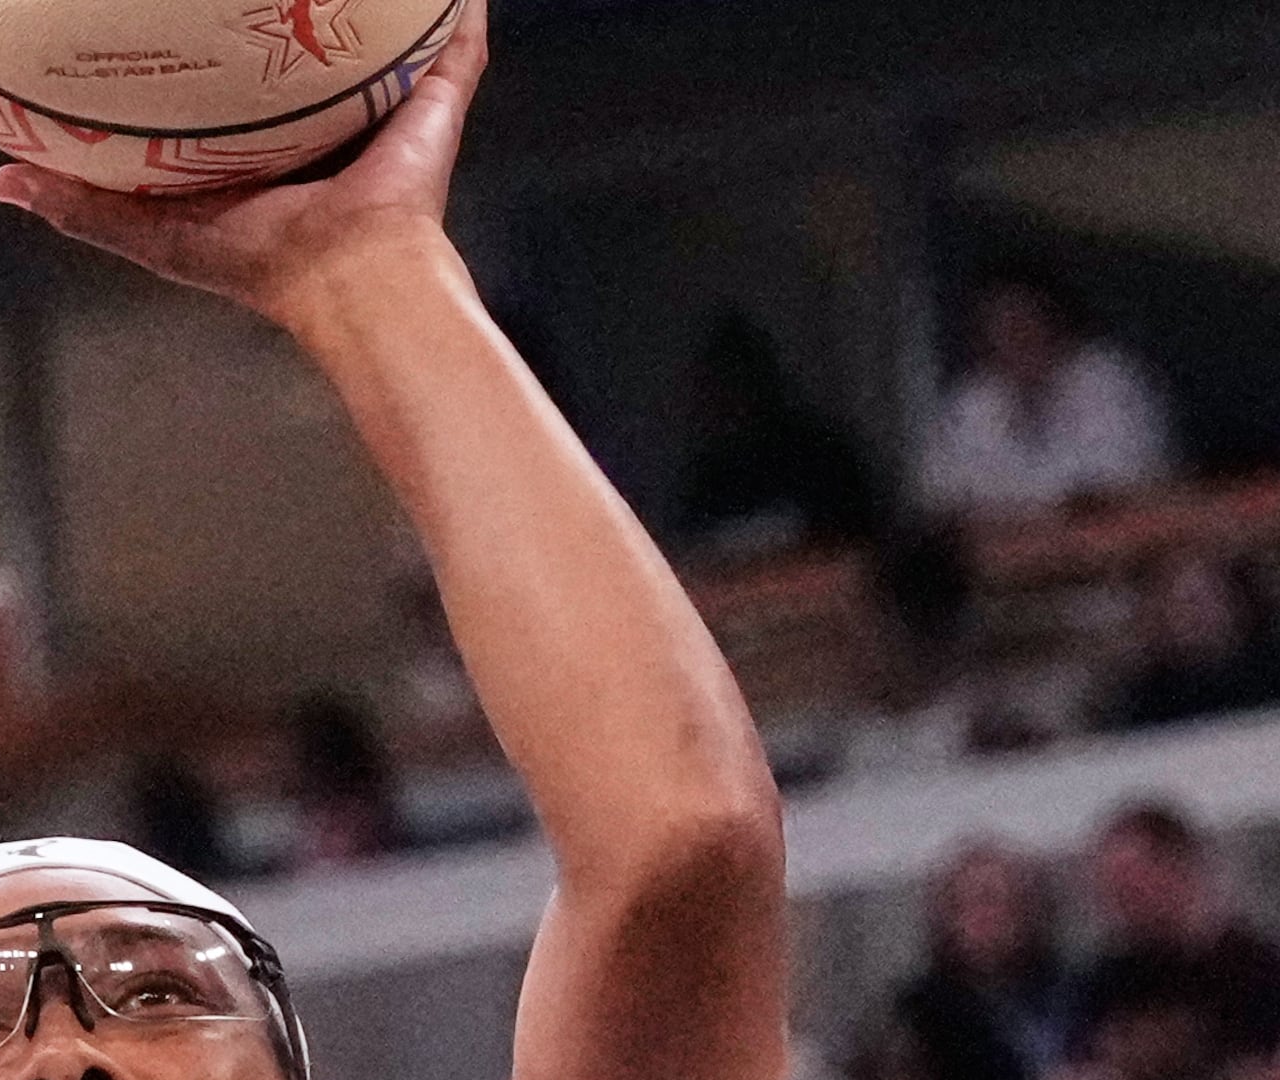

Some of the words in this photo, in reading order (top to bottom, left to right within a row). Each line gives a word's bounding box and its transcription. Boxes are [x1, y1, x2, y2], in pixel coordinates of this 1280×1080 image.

[76, 50, 181, 62] OFFICIAL
[44, 66, 155, 78] ALL-STAR
[159, 59, 222, 75] BALL
